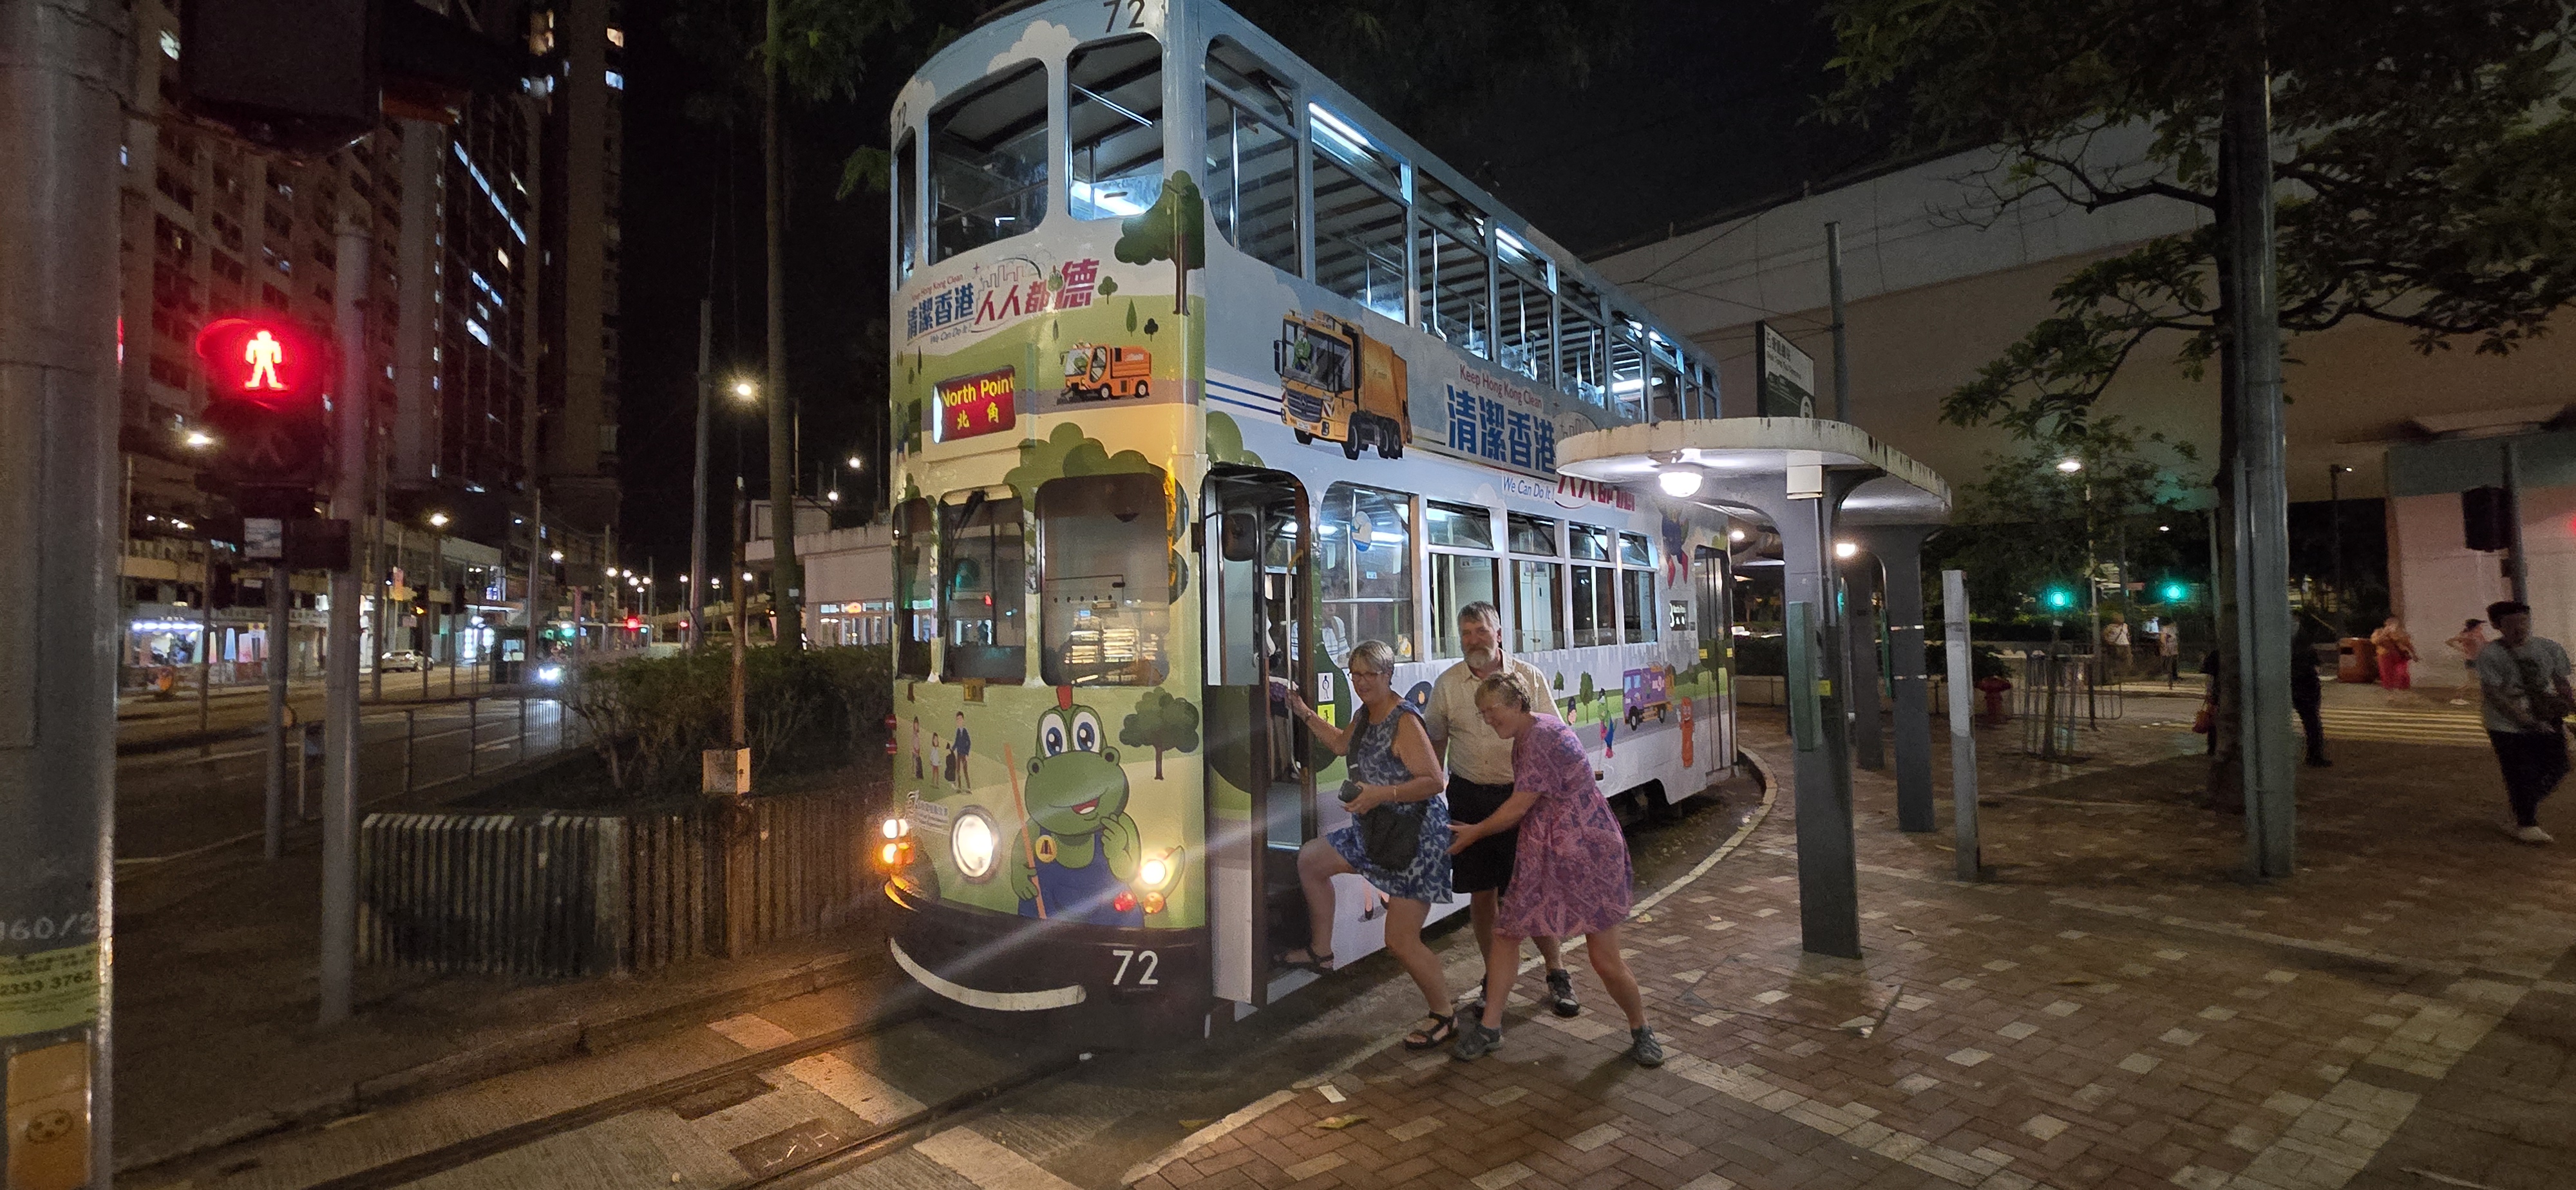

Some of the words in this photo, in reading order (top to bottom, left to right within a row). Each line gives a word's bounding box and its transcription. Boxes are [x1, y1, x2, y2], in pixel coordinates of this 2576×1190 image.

[1103, 0, 1145, 33] 72
[907, 282, 974, 341] 清潔香港
[941, 383, 976, 408] North
[980, 372, 1016, 399] Point
[1459, 363, 1481, 390] Keep
[1482, 372, 1502, 399] Hong
[1504, 381, 1522, 406] Kong
[1524, 390, 1542, 409] Clean
[1446, 383, 1556, 475] 清潔香港
[1503, 476, 1516, 493] We
[1518, 479, 1532, 496] Can
[1533, 482, 1544, 498] Do
[1112, 949, 1159, 986] 72
